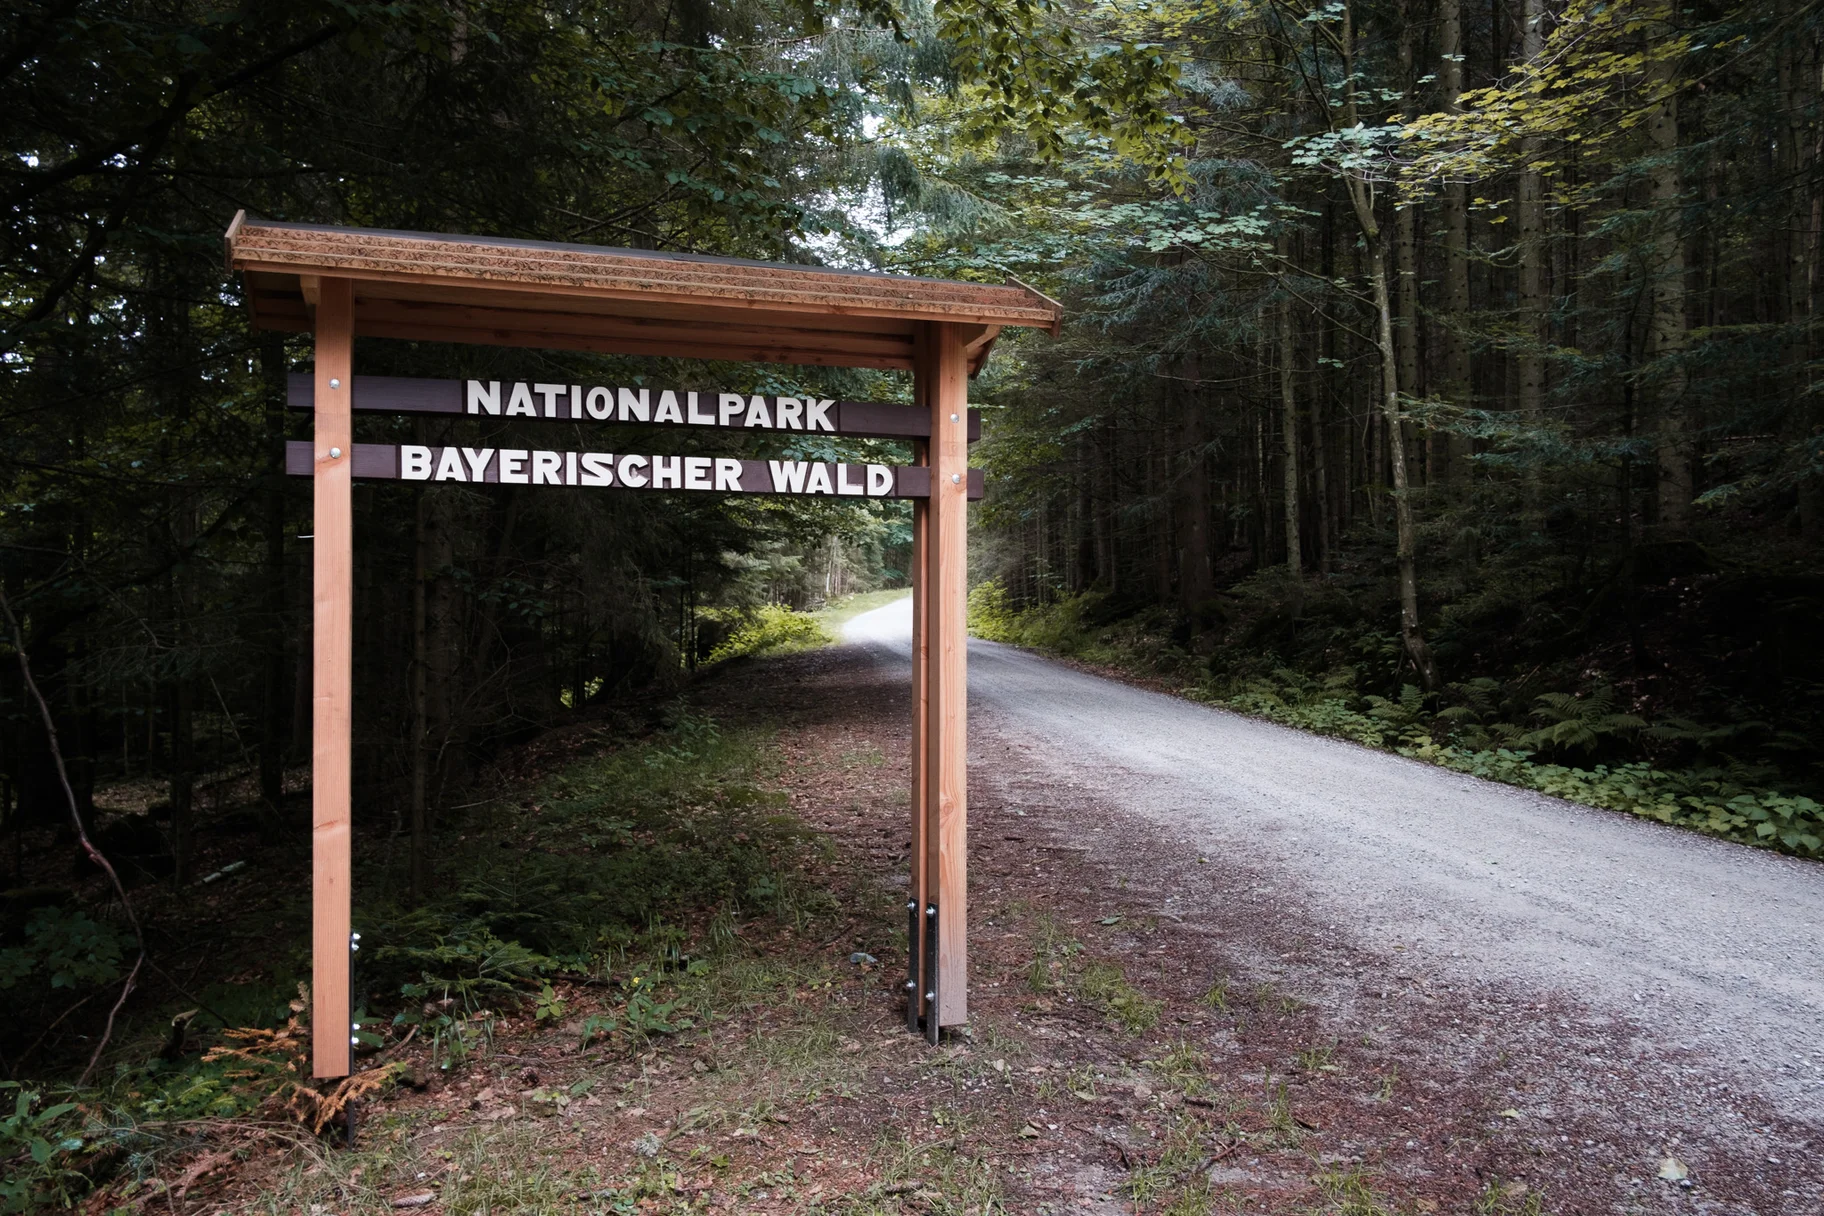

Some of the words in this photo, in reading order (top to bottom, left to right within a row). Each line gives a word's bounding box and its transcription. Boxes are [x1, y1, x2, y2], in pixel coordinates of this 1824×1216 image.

[466, 380, 837, 432] NATIONALPARK
[400, 444, 744, 492] BAYERISCHER
[768, 459, 895, 497] WALD
